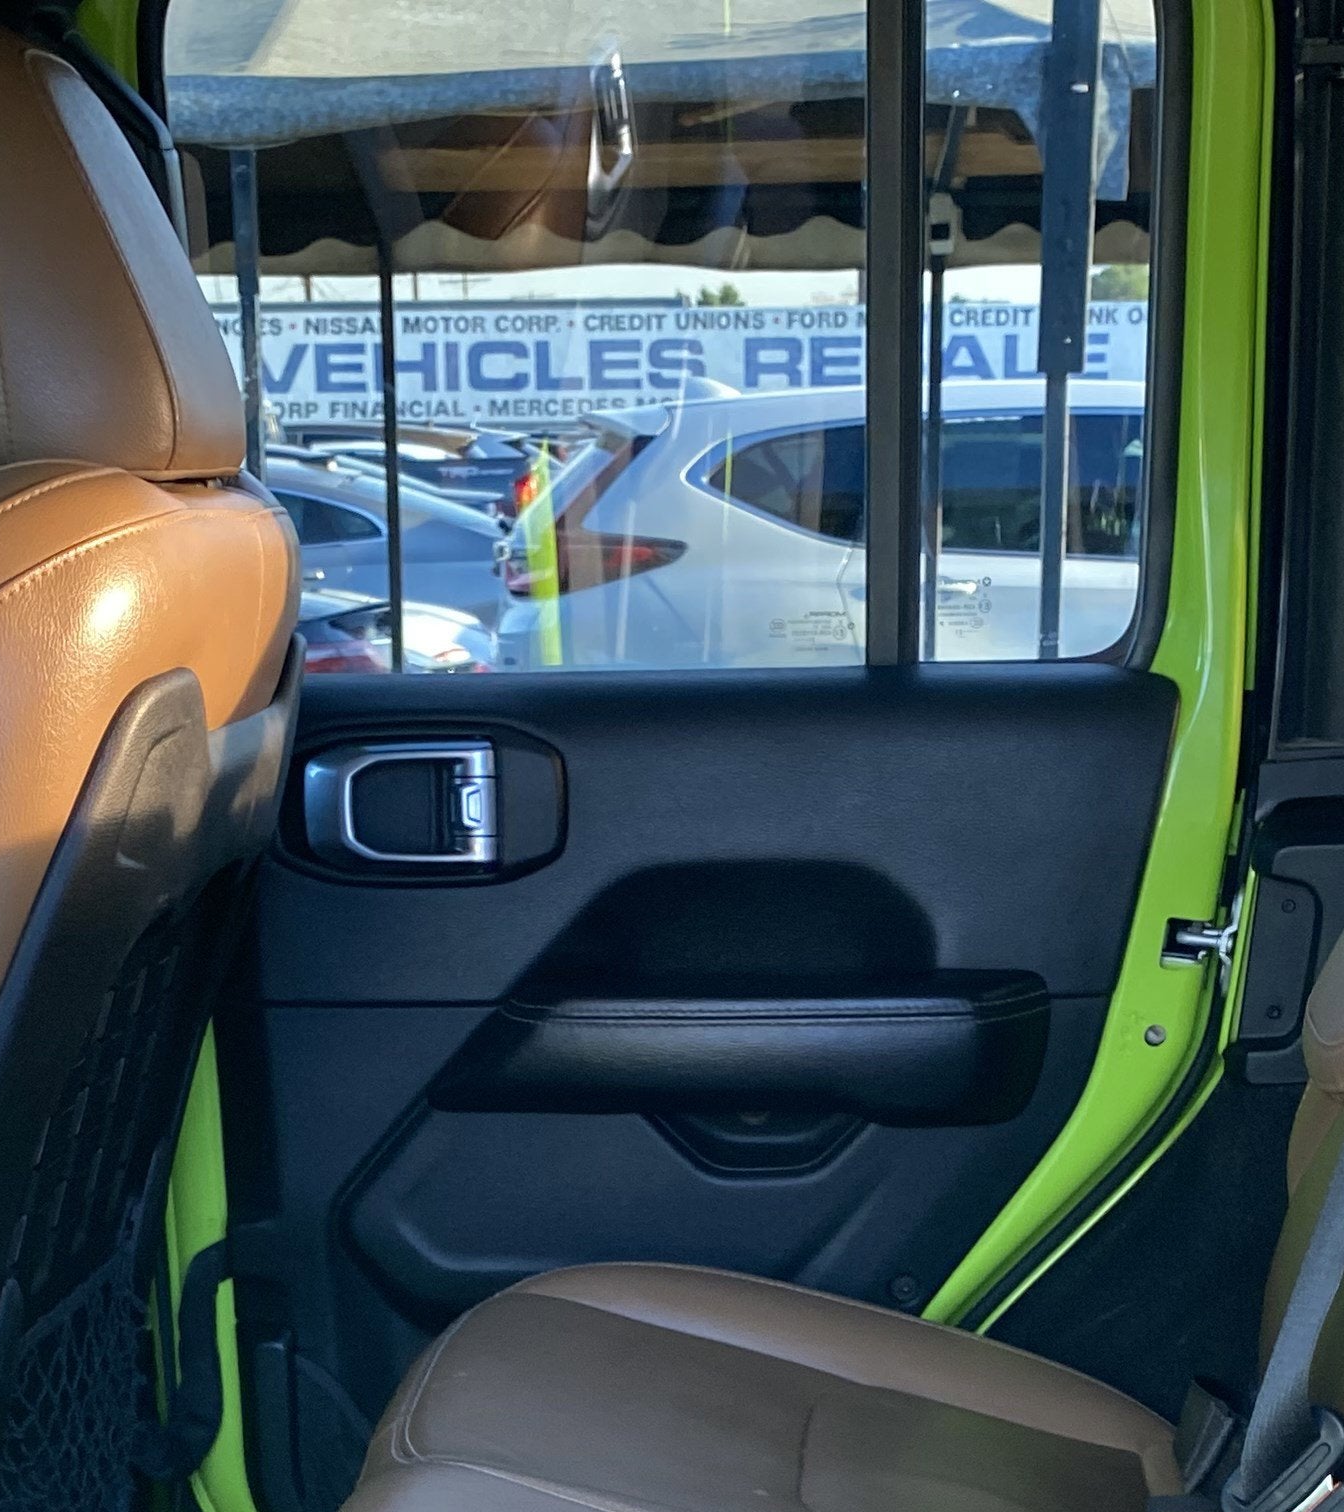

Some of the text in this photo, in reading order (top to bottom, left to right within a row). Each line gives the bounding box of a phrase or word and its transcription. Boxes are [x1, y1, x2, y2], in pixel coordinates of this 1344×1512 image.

[304, 317, 383, 336] NISSA
[402, 316, 485, 334] MOTOR
[584, 314, 666, 331] CREDIT
[675, 312, 765, 330] UNIONS
[787, 311, 848, 328] FORD
[949, 307, 1034, 327] CREDIT
[261, 338, 705, 394] VEHICLES
